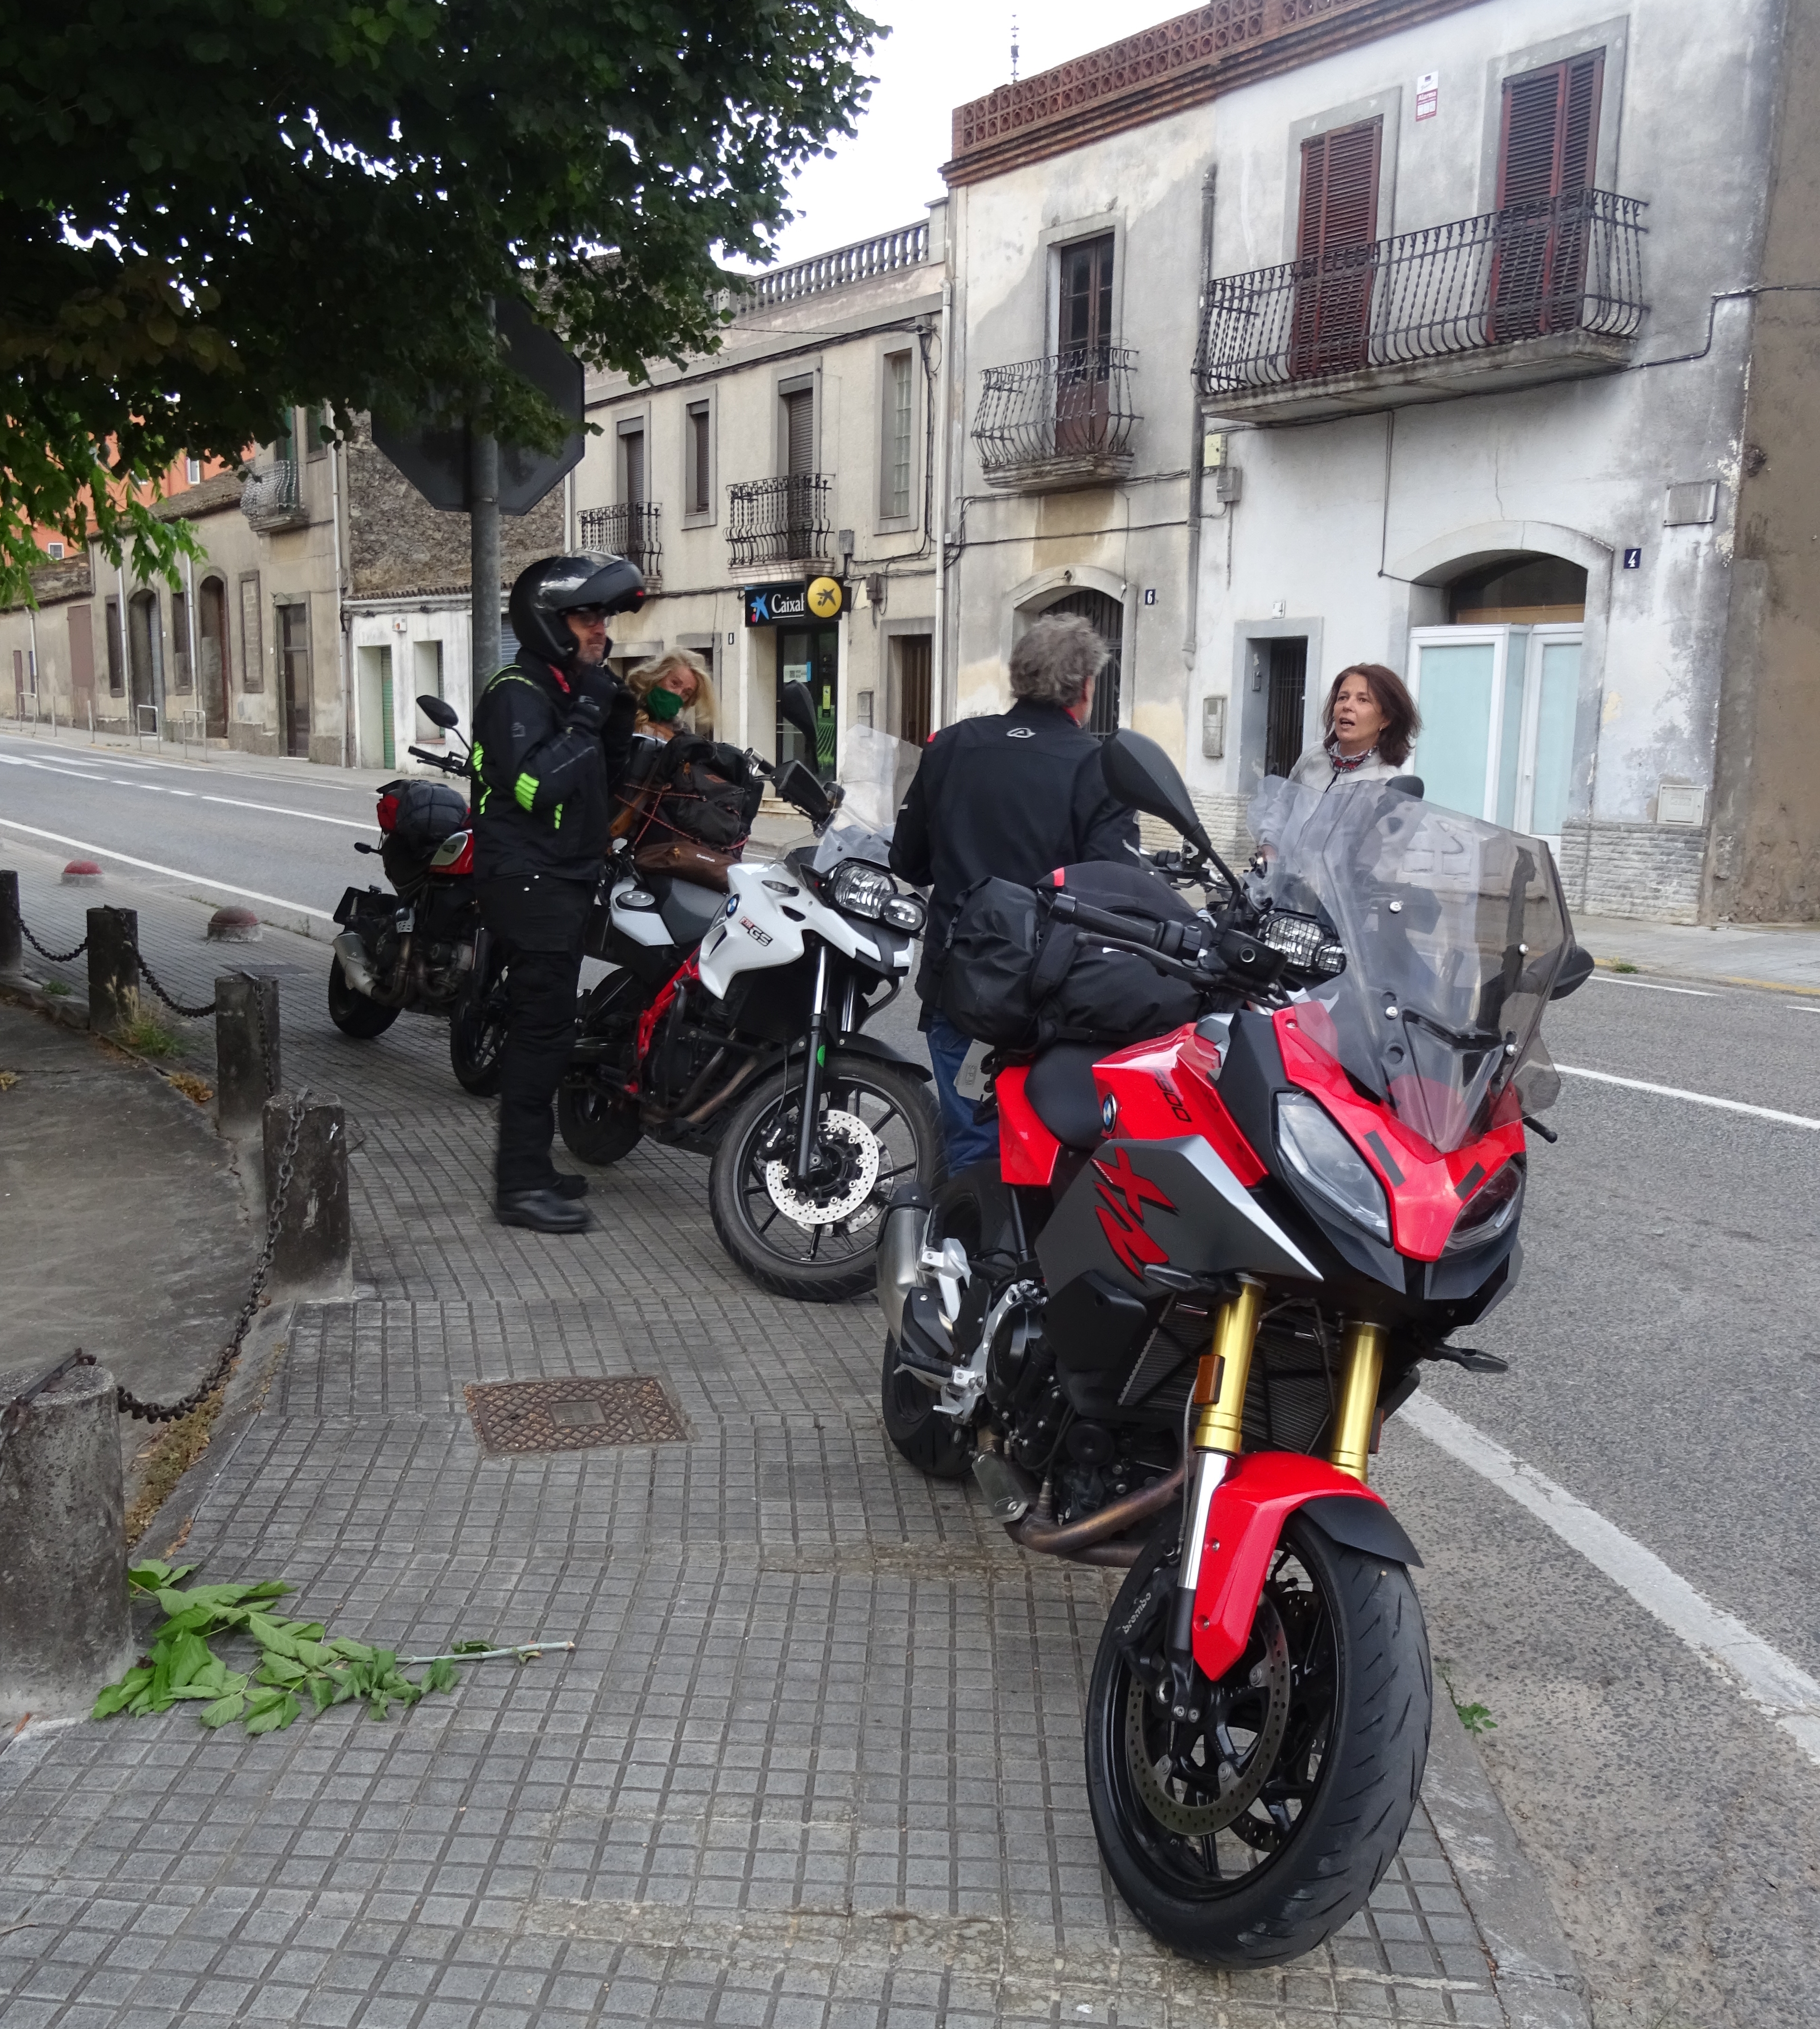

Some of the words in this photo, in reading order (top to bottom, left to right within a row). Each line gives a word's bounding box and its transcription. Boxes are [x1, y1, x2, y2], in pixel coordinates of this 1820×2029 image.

[1628, 550, 1637, 567] 4
[771, 592, 805, 614] Caixa
[1147, 590, 1153, 604] 6
[1122, 1592, 1152, 1634] brembo
